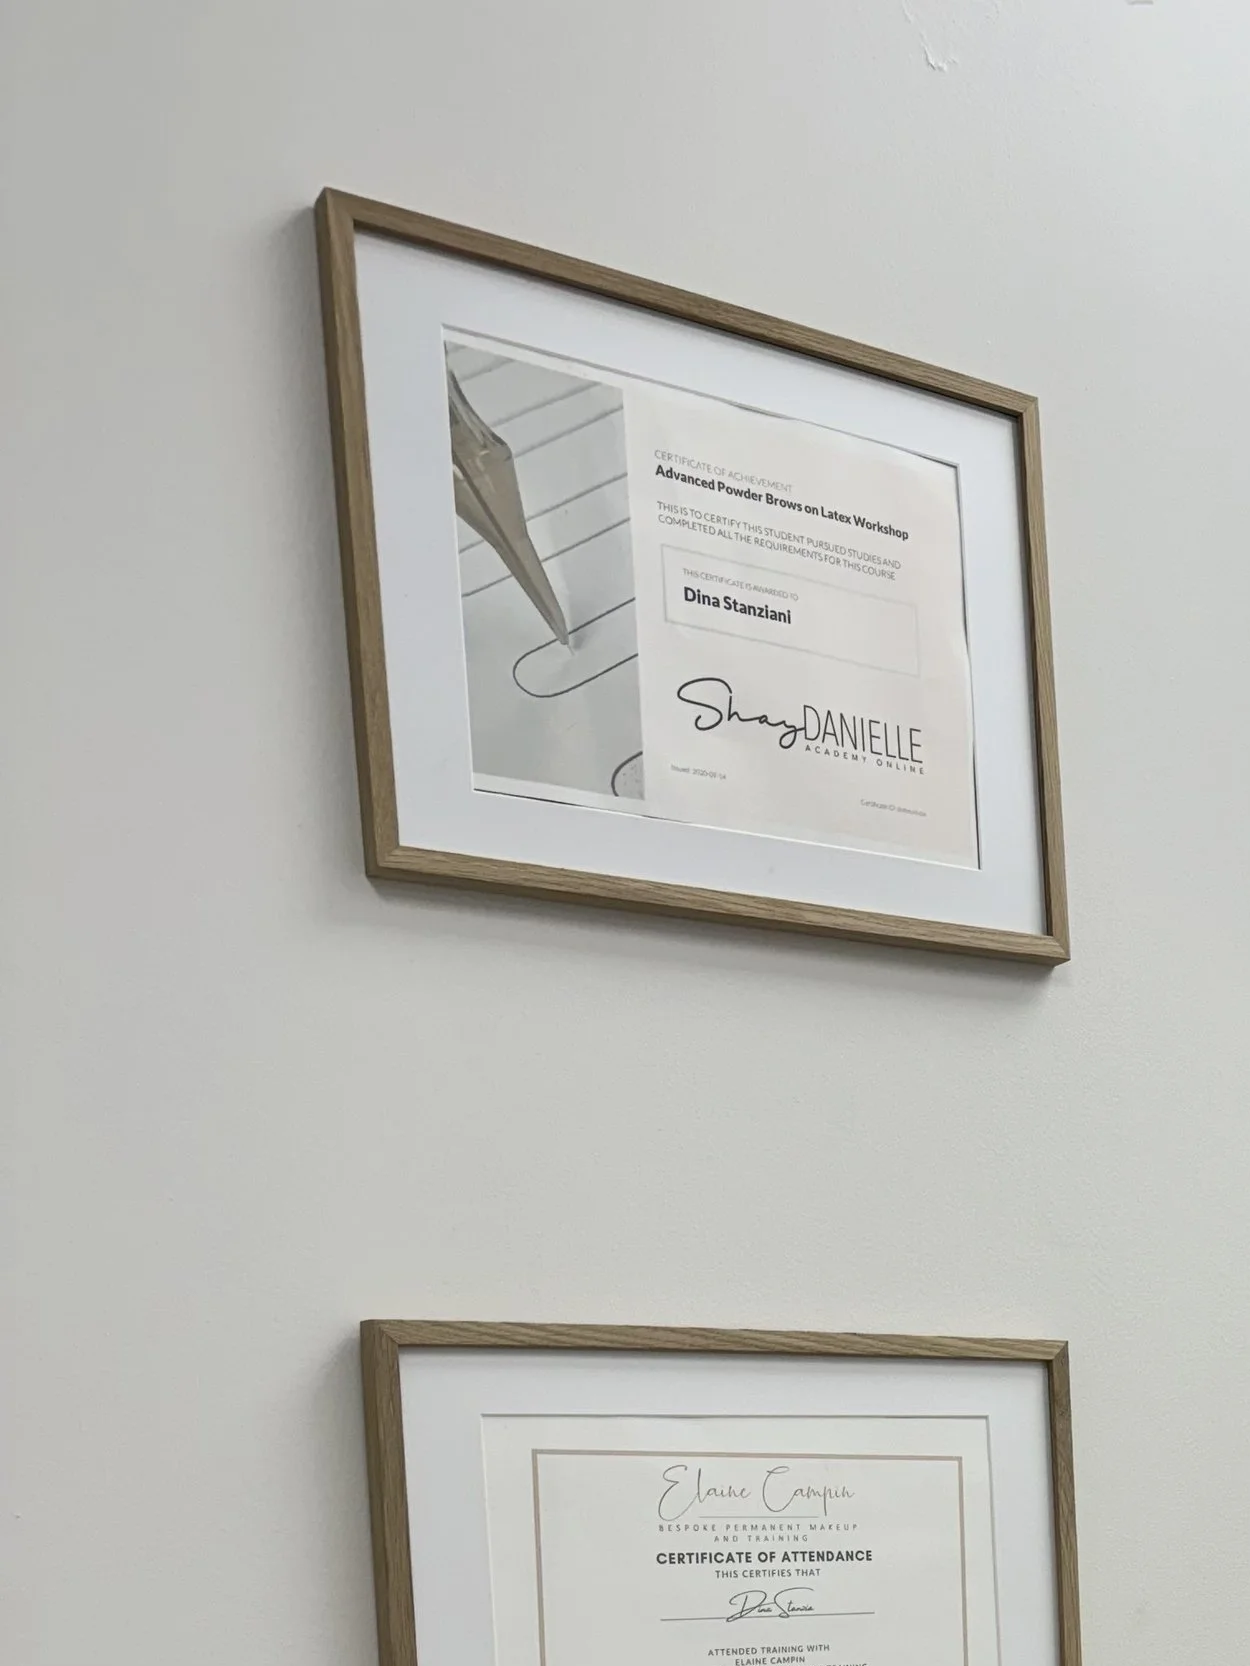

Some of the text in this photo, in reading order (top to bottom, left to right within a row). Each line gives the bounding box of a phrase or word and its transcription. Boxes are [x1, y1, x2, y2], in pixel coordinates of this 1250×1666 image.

[653, 449, 792, 493] CERTIFICATE OF ACHIEVEMENT
[655, 464, 909, 542] Advanced Powder Brows on Latex Workshop
[656, 500, 902, 570] THIS IS TO CERTIFY THIS STUDENT PURSUED STUDIES AND
[657, 513, 896, 581] COMPLETED ALL THE REQUIREMENTS FOR THIS COURSE
[683, 586, 791, 625] Dina Stanziani
[804, 744, 924, 775] ACADEMY ONLINE
[658, 1465, 855, 1522] Elaine Campin
[658, 1523, 857, 1532] BESPOKE PERMANENT MAKEUP
[713, 1534, 808, 1543] AND TRAINING
[655, 1549, 873, 1565] CERTIFICATE OF ATTENDANCE
[714, 1568, 821, 1579] THIS CERTIFIES THAT
[707, 1644, 830, 1657] ATTENDED TRAINING WITH
[735, 1655, 806, 1666] ELAINE CAMPIN
